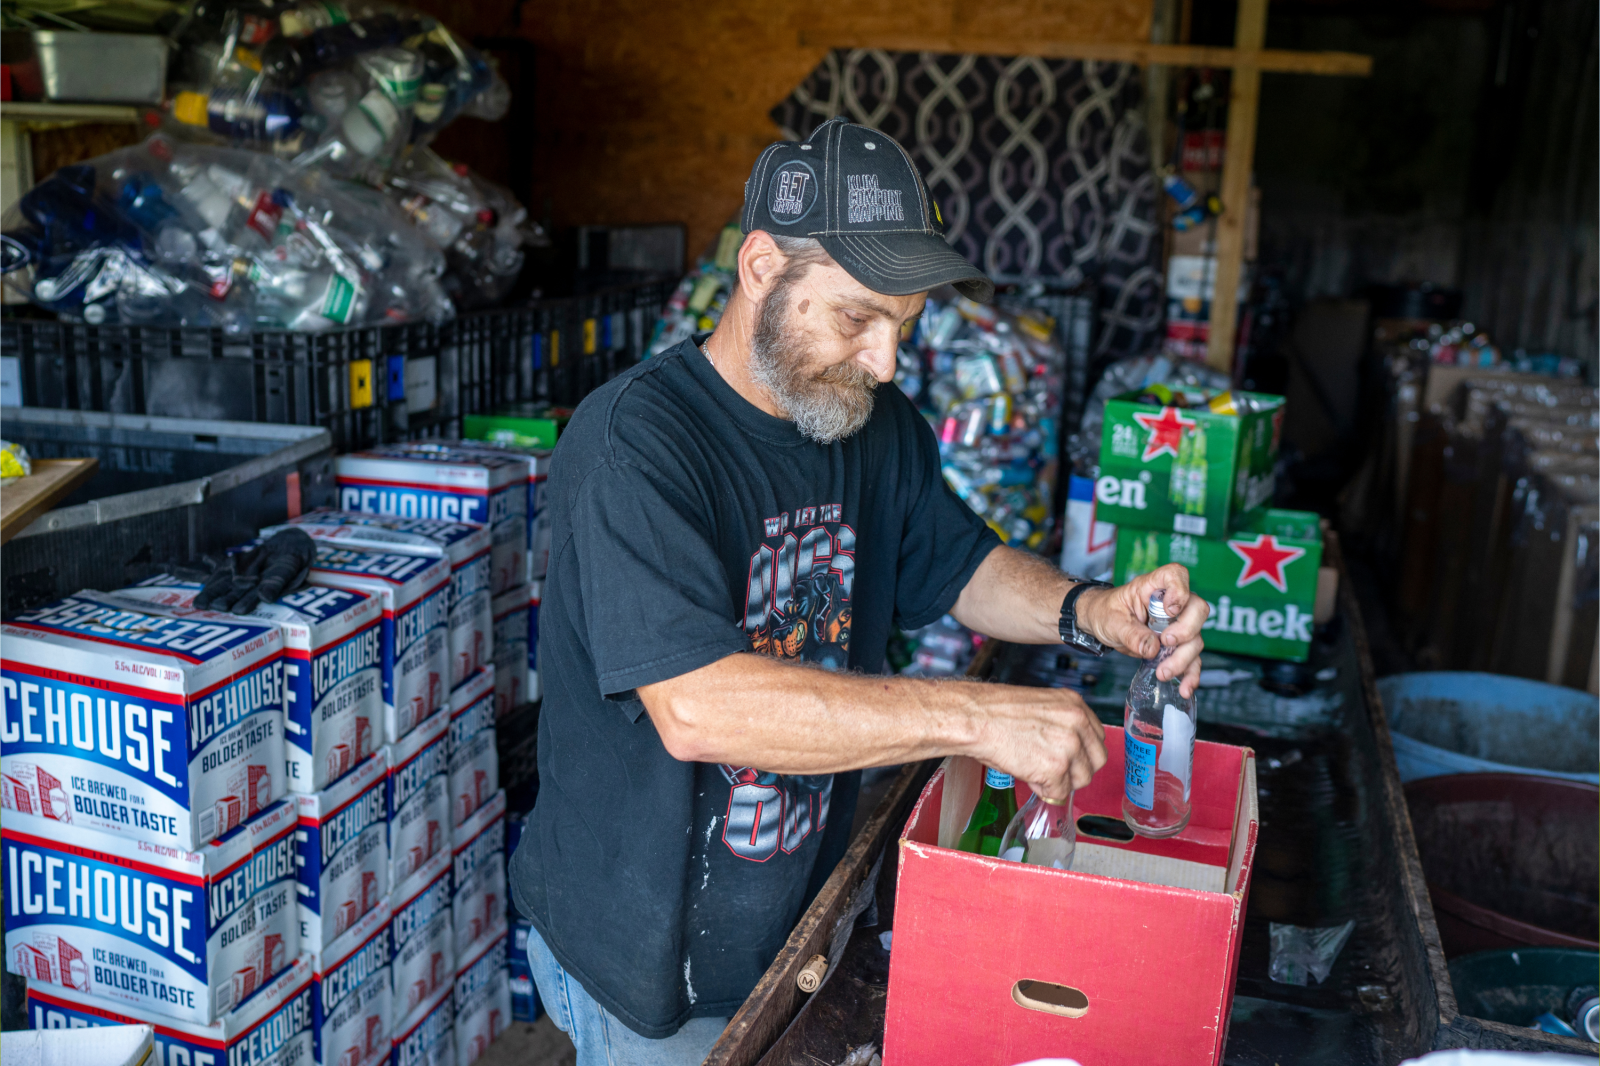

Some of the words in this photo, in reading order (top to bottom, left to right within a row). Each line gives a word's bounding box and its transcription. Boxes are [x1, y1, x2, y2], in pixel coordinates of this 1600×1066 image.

[776, 171, 810, 202] GET
[848, 204, 904, 223] MAPPING
[794, 507, 817, 528] LET
[820, 504, 841, 523] THE
[1202, 596, 1314, 642] einek
[132, 663, 157, 678] ALC/VOL
[313, 626, 381, 701] ICEHOUSE
[192, 660, 282, 752] ICEHOUSE
[202, 739, 243, 774] BOLDER
[245, 719, 274, 749] TASTE
[71, 775, 86, 792] ICE
[88, 779, 127, 801] BREWED
[73, 793, 130, 825] BOLDER
[131, 807, 178, 837] TASTE
[210, 832, 295, 929] ICEHOUSE
[9, 846, 195, 964] ICEHOUSE
[259, 888, 287, 921] TASTE
[93, 947, 107, 964] ICE
[108, 951, 147, 975] BREWED
[94, 964, 149, 997] BOLDER
[150, 980, 196, 1019] TASTE
[801, 976, 814, 988] M
